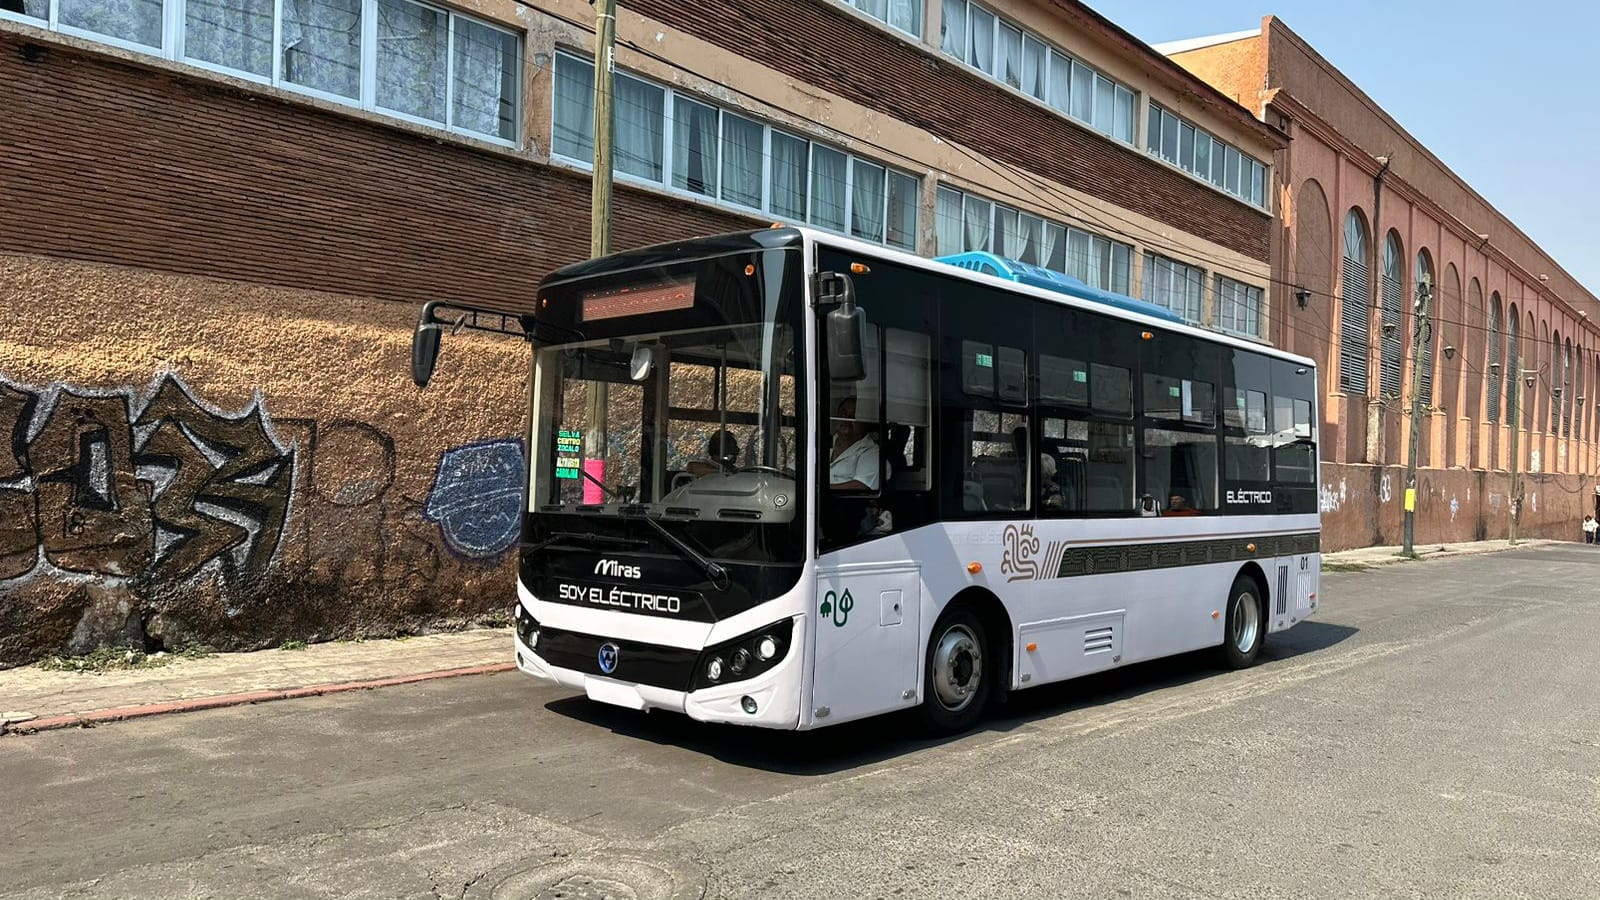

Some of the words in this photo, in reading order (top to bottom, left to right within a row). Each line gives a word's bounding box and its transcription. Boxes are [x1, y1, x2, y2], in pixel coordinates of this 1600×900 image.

[557, 437, 580, 446] CENTRO
[1226, 487, 1272, 504] ELÉCTRICO
[593, 559, 642, 579] Miras
[1300, 556, 1309, 571] 01
[559, 583, 587, 601] SOY
[588, 586, 681, 613] ELÉCTRICO
